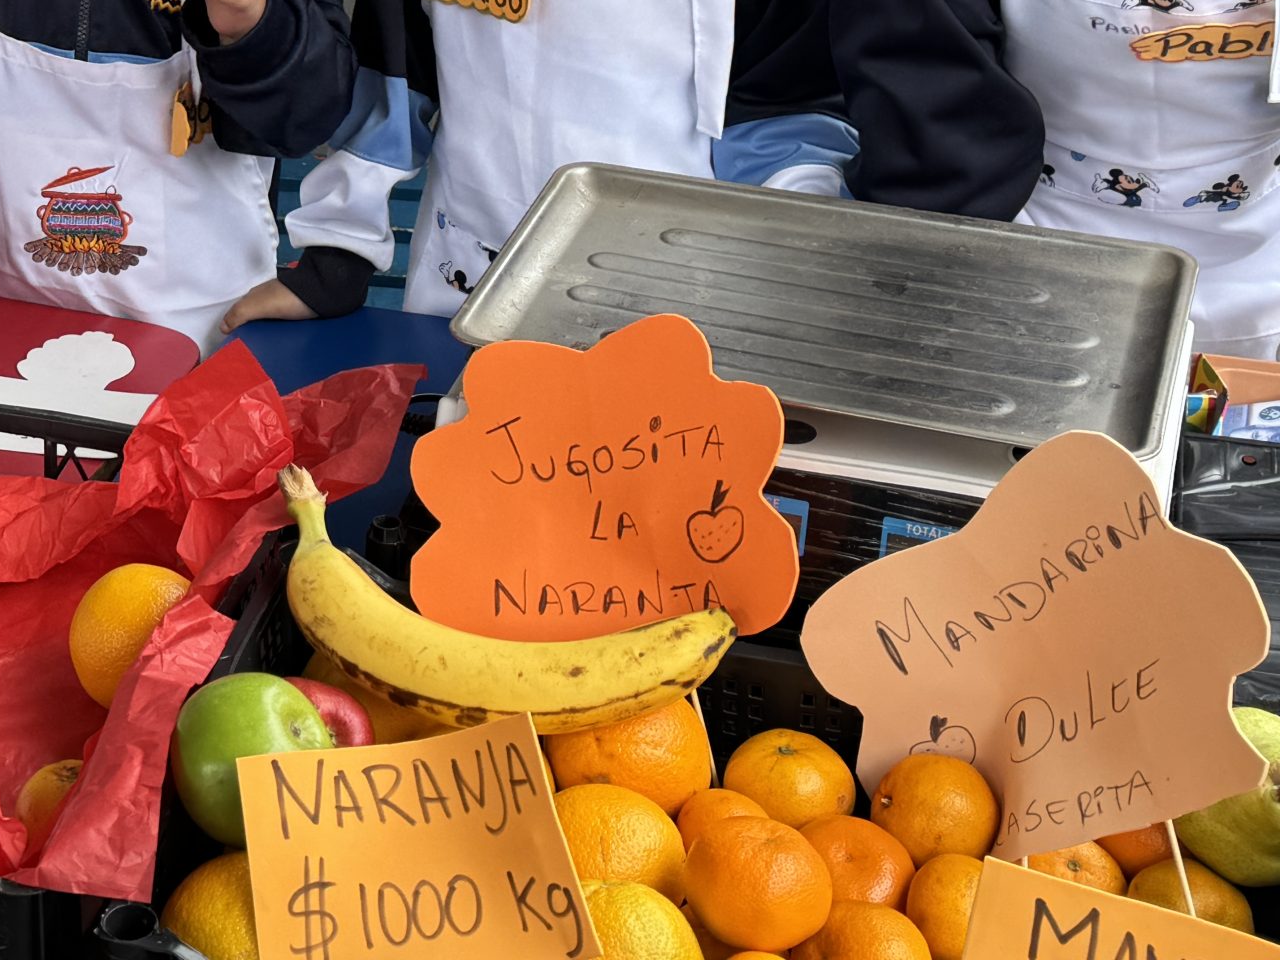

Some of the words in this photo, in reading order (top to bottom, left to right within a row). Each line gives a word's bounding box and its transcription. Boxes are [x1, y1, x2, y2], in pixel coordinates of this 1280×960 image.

[1156, 30, 1274, 57] Pabl
[590, 500, 639, 541] LA
[271, 739, 538, 839] NARANJA
[288, 856, 483, 960] $1000
[506, 870, 584, 959] Kg
